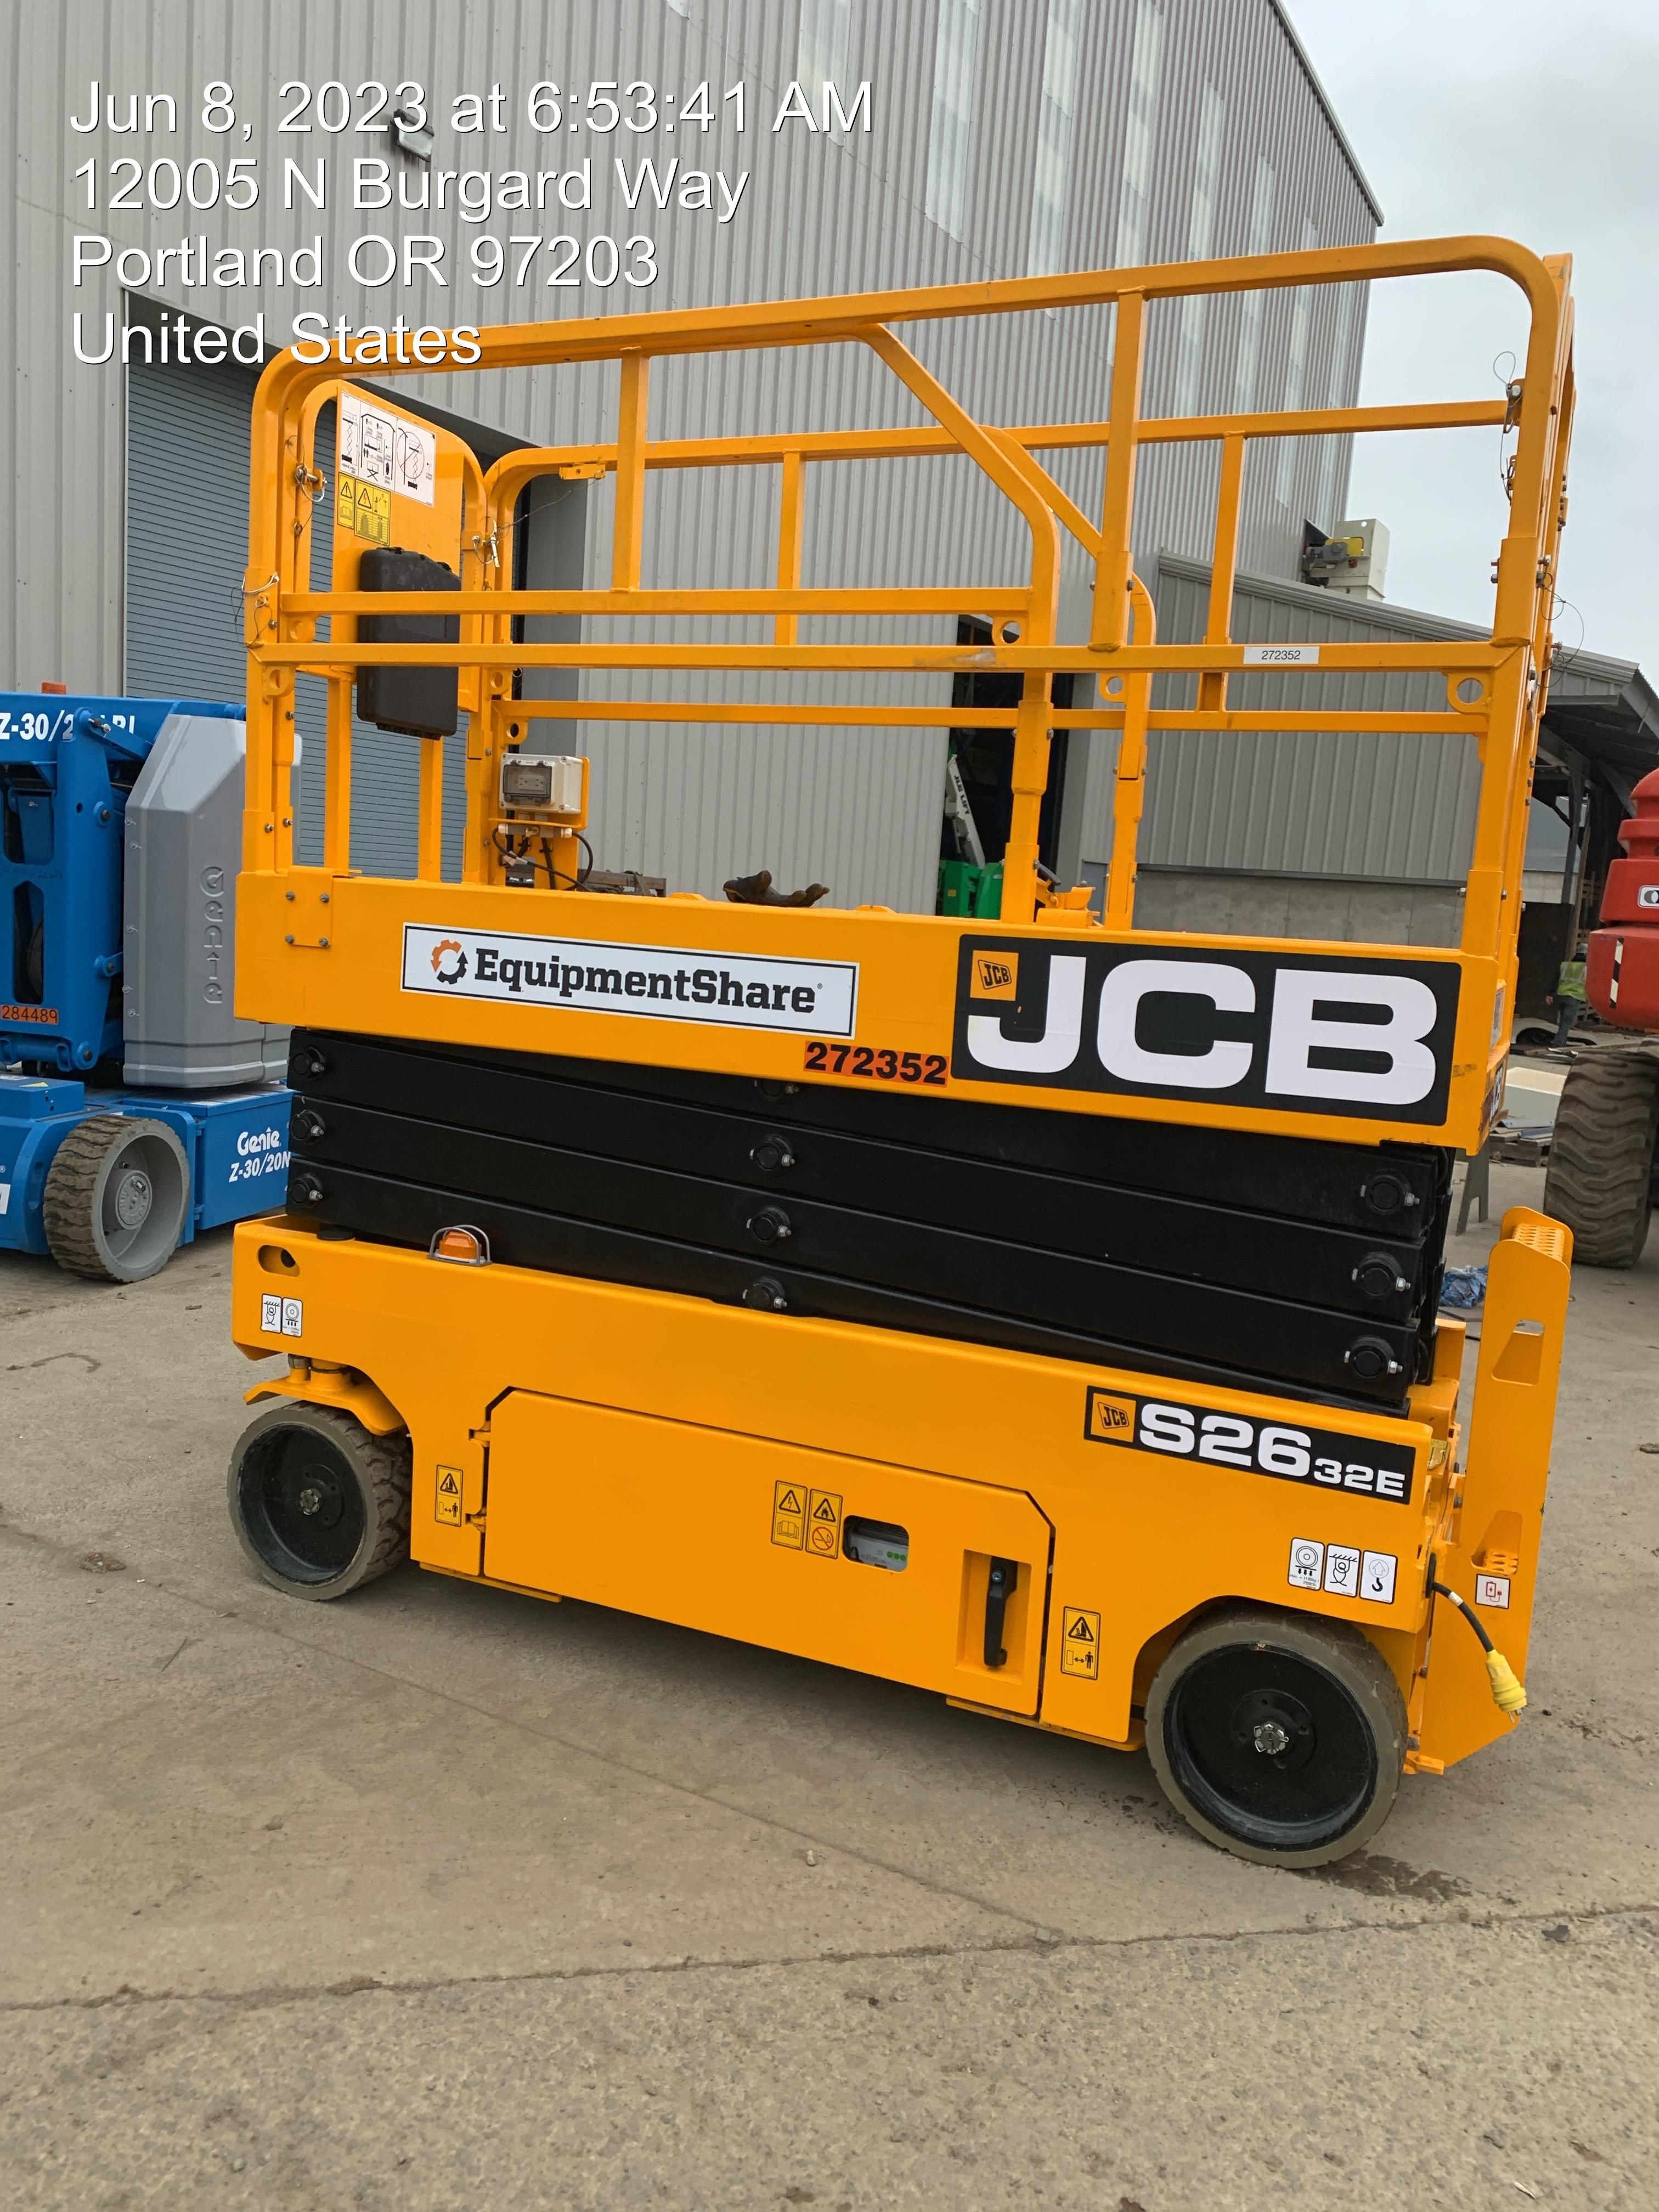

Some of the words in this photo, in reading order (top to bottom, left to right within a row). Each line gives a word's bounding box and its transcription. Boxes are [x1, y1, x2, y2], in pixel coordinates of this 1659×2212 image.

[1261, 650, 1301, 660] 272352
[474, 947, 816, 1014] EquipmentShare
[983, 963, 1010, 986] JCB
[2, 1005, 58, 1023] 284489
[967, 955, 1437, 1105] JCB
[805, 1041, 947, 1085] 272352
[237, 1126, 280, 1156] Genie
[228, 1150, 291, 1183] Z-30/20N
[1103, 1406, 1127, 1426] JCB
